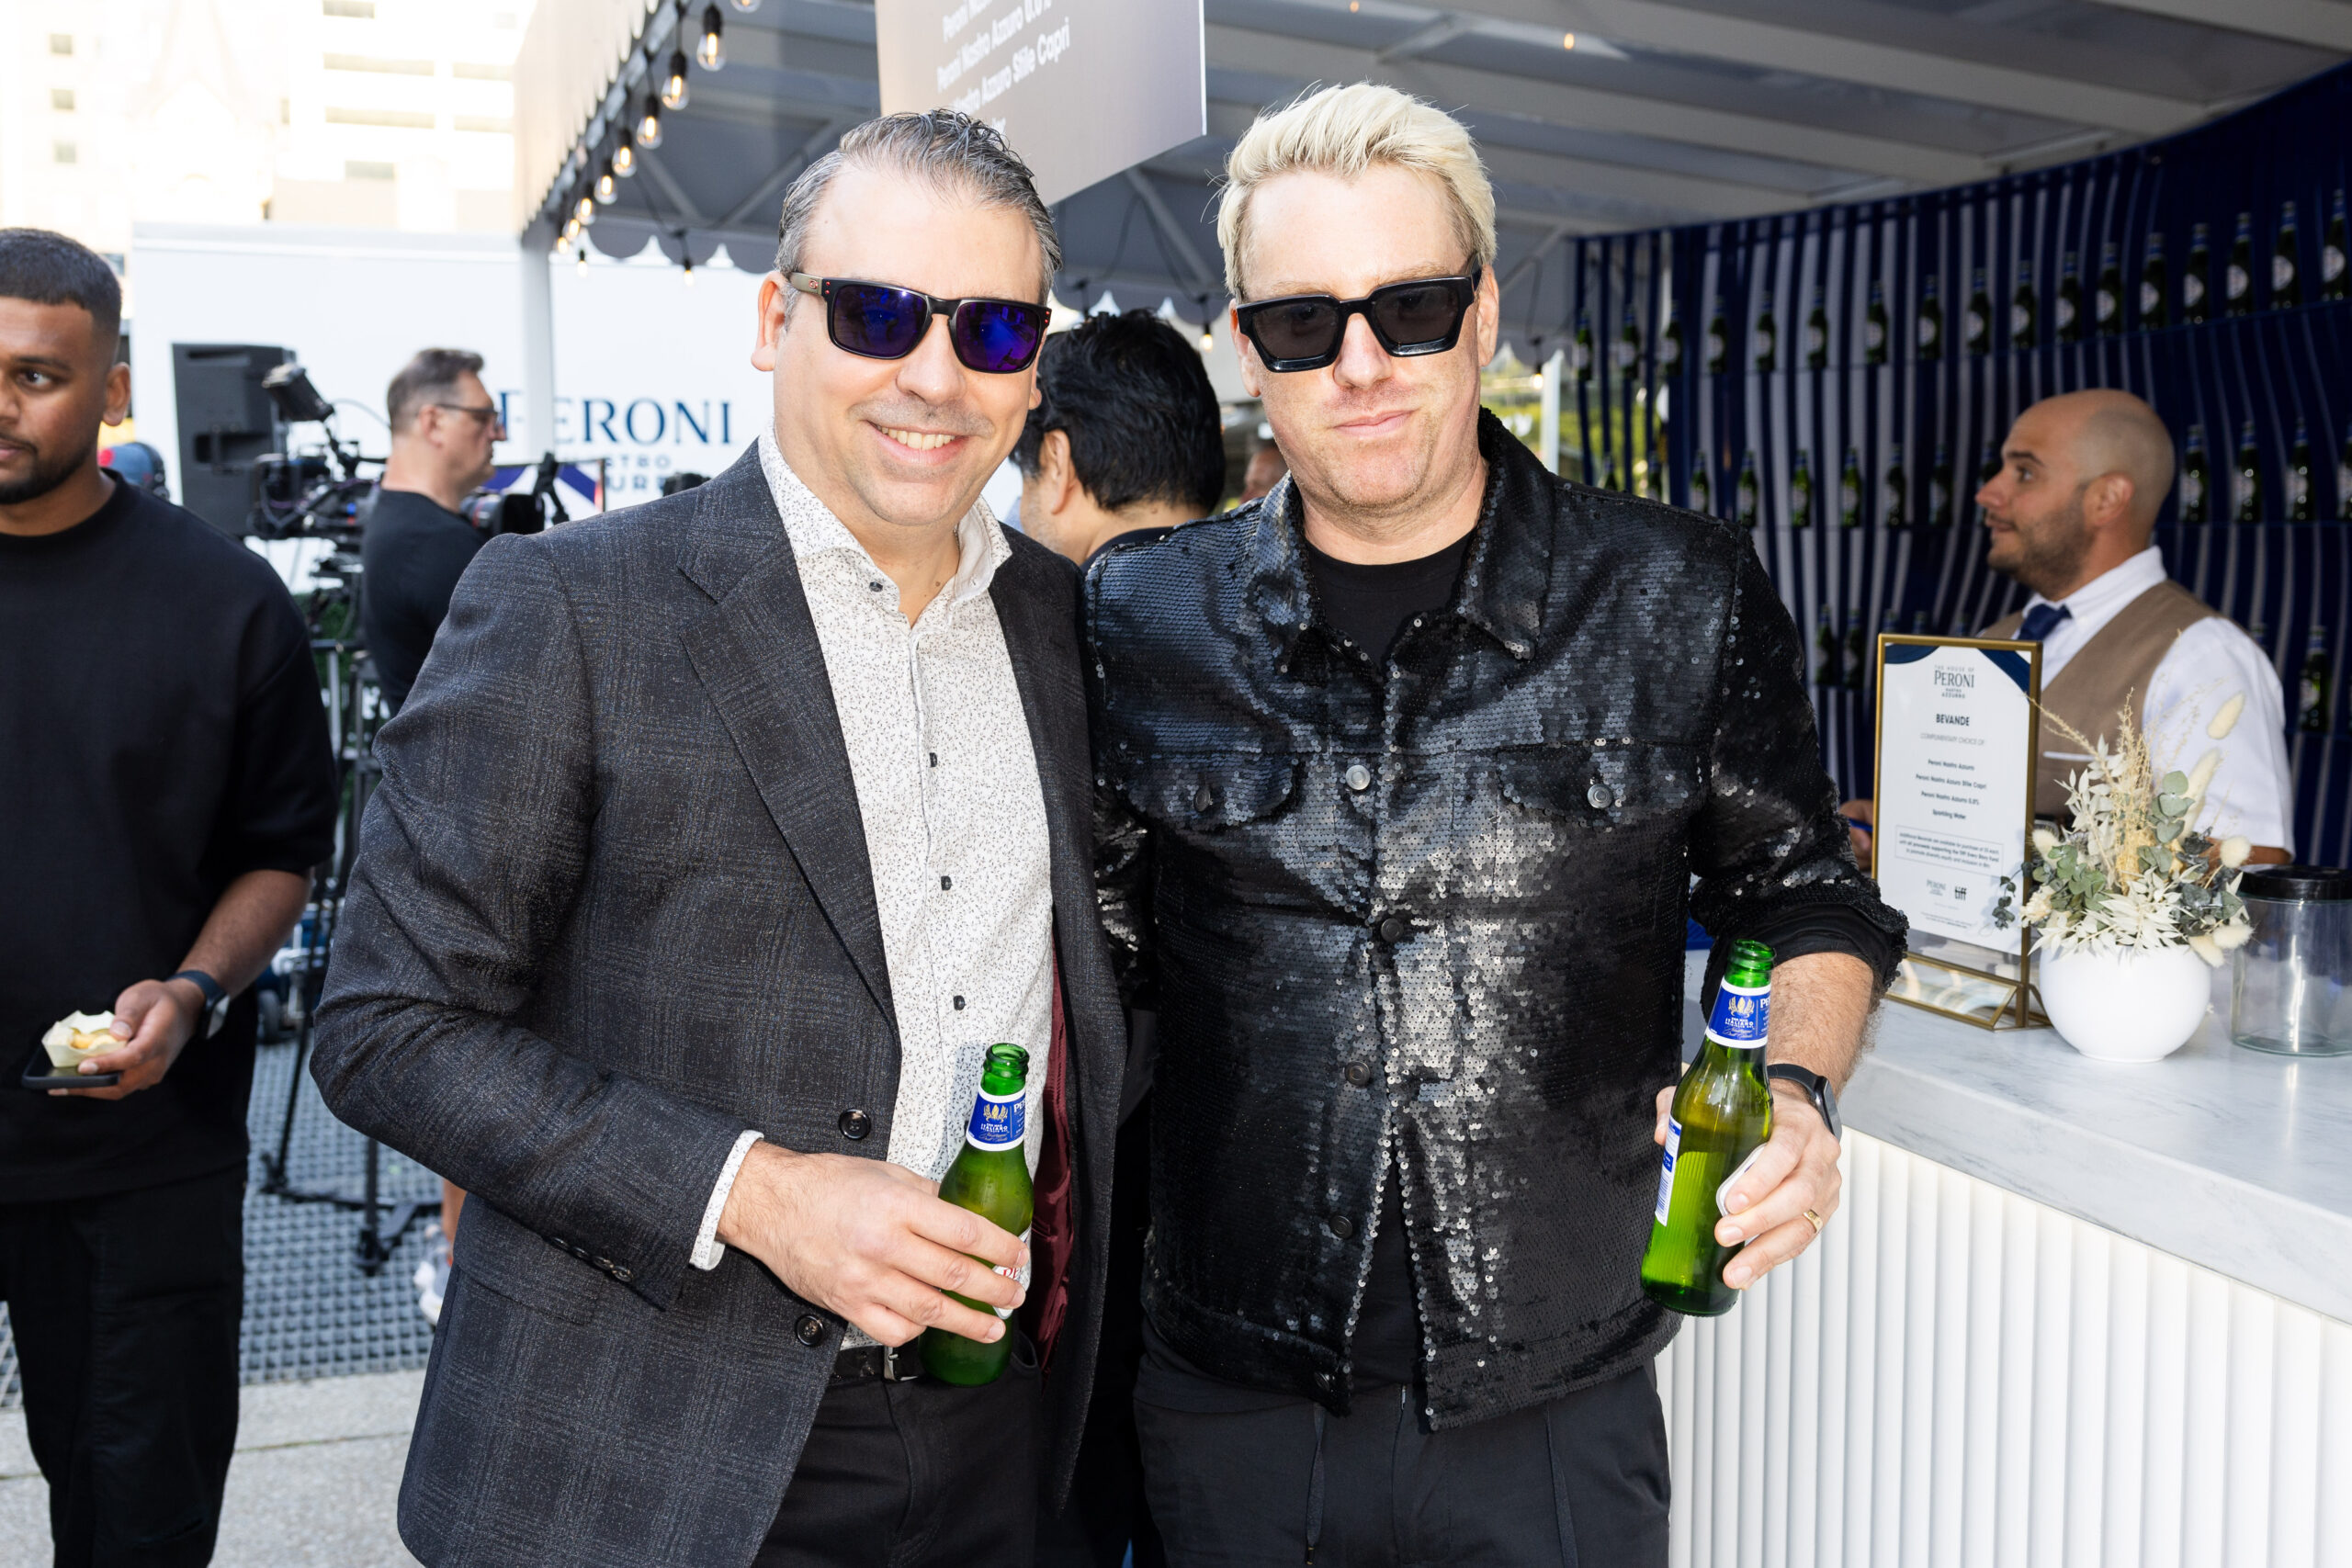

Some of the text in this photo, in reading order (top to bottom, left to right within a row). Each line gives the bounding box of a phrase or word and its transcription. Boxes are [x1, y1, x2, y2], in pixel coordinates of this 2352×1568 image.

[1037, 16, 1069, 65] Capri
[1934, 670, 1974, 688] PERONI
[1936, 714, 1970, 726] BEVANDE
